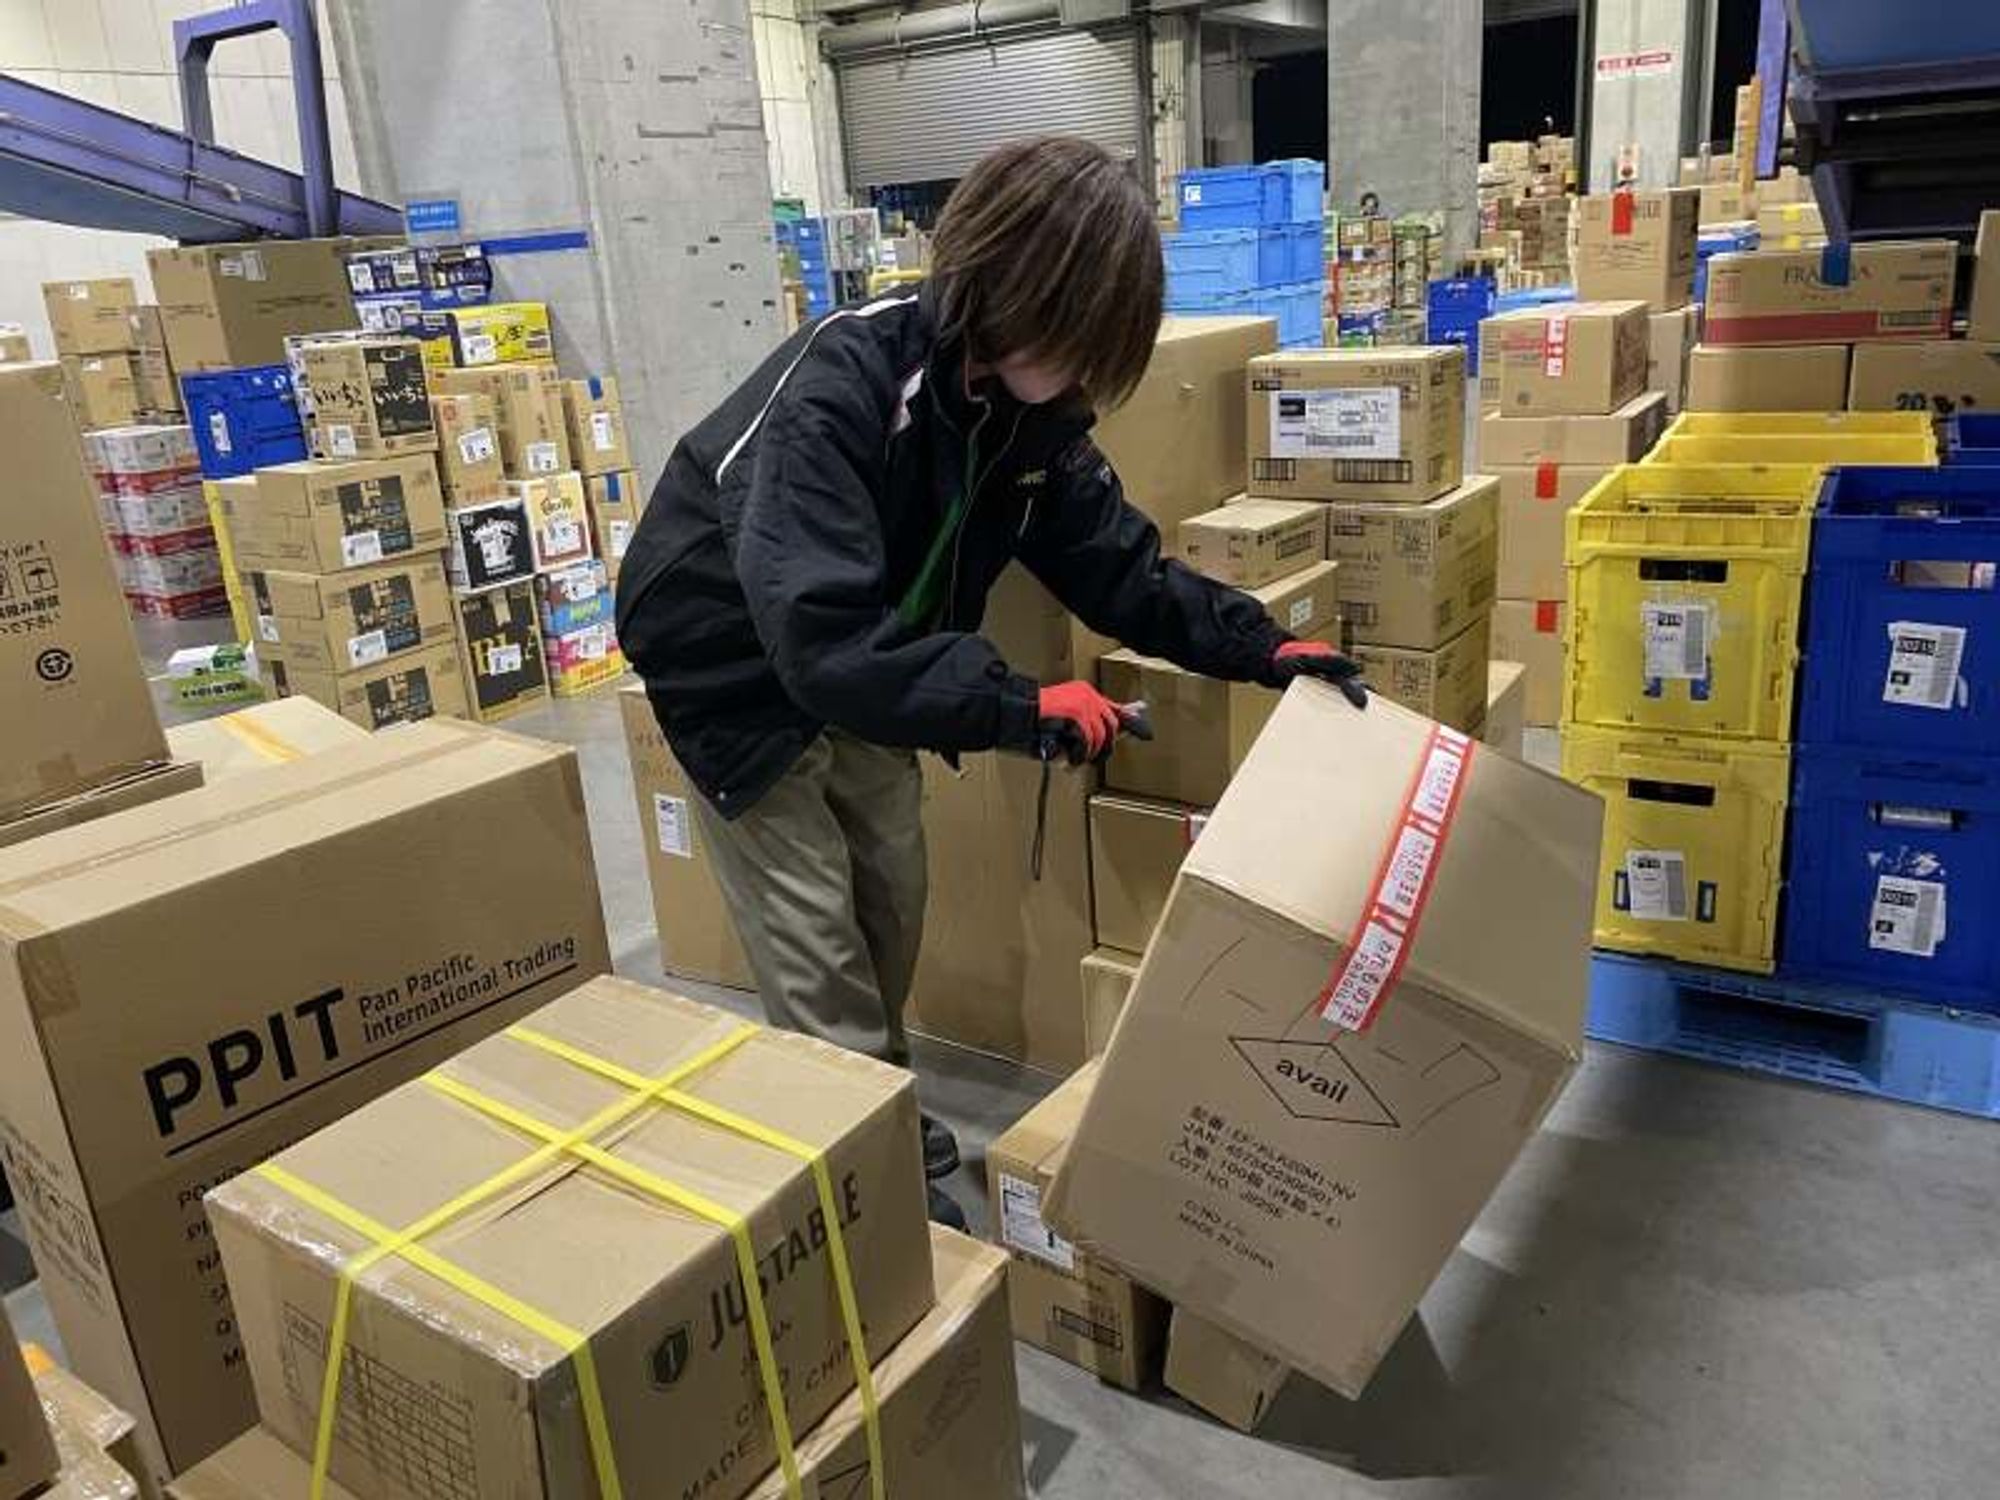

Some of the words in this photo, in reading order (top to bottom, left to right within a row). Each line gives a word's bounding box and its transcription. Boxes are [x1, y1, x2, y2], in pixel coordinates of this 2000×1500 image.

[358, 987, 400, 1018] Pan
[405, 952, 475, 996] Pacific
[362, 968, 499, 1043] International
[503, 936, 576, 981] Trading
[143, 987, 345, 1137] PPIT
[1275, 1056, 1350, 1104] avail
